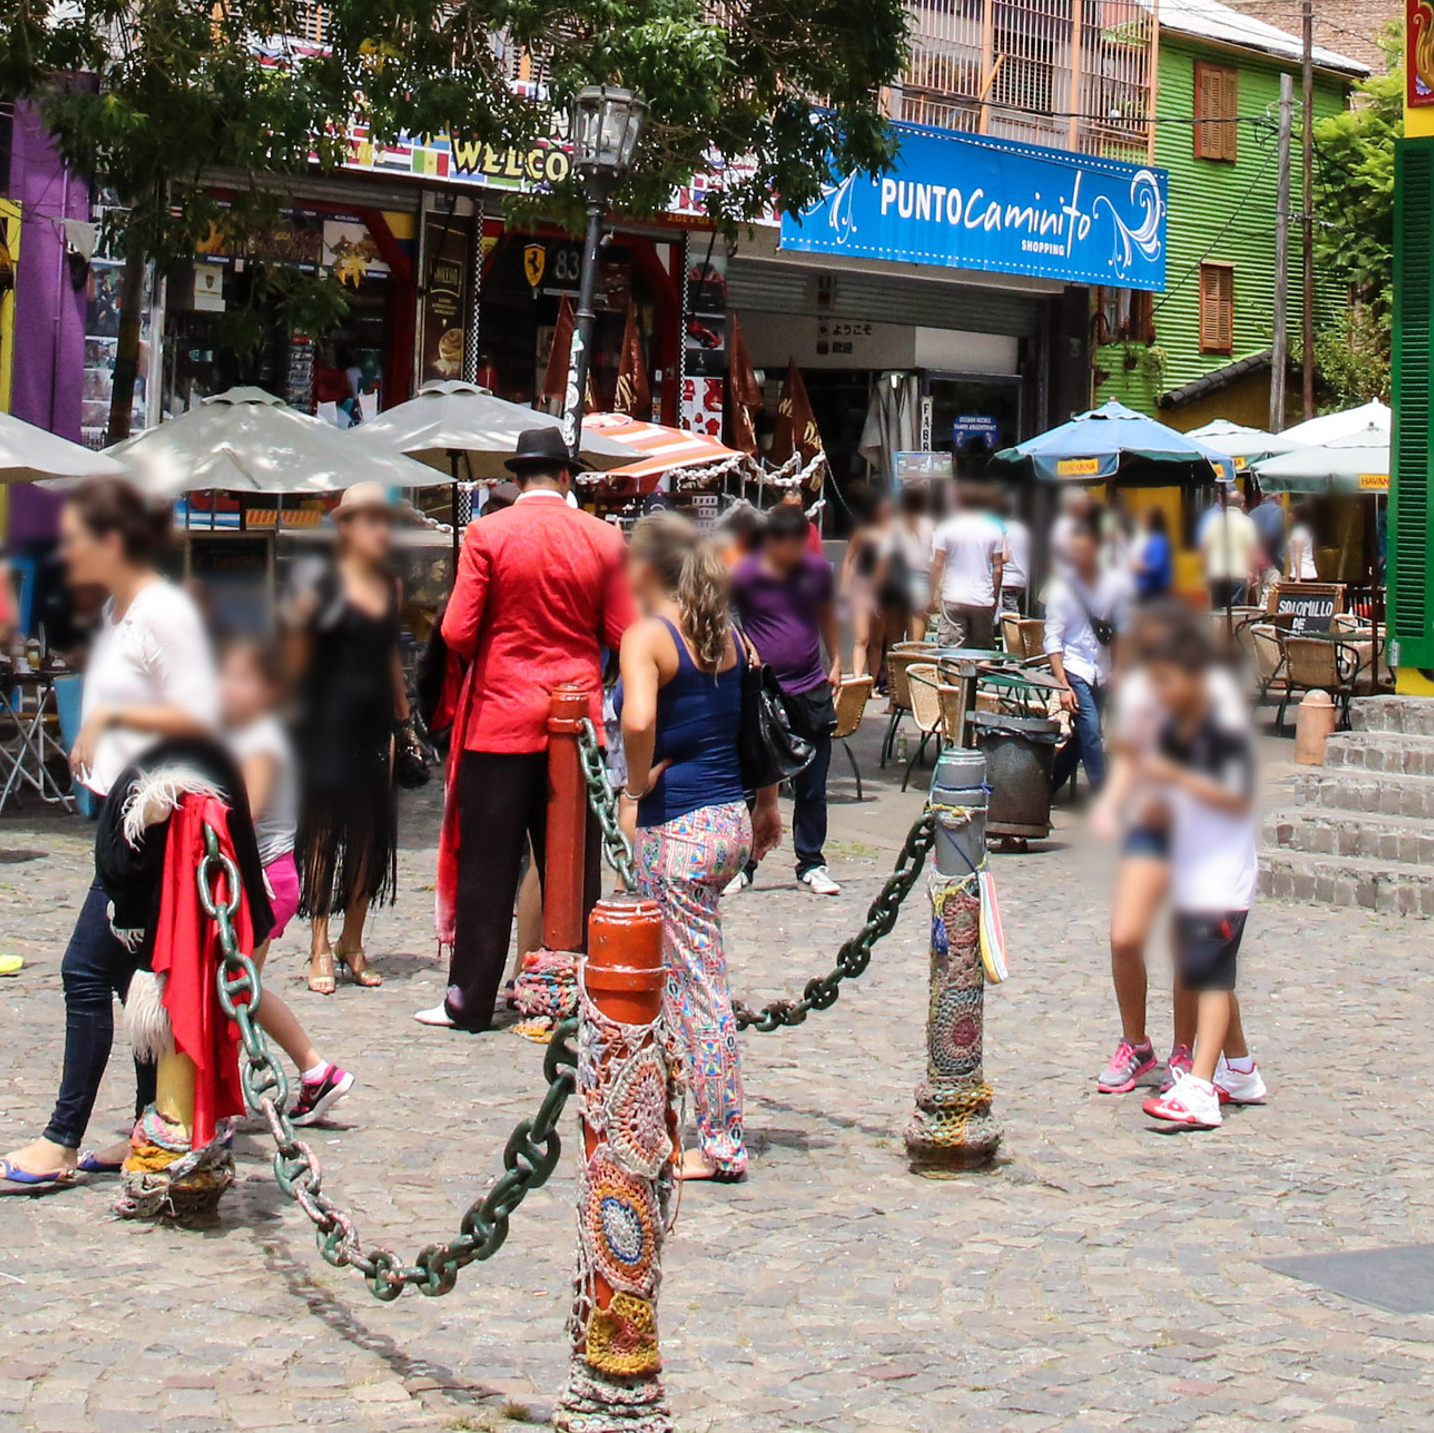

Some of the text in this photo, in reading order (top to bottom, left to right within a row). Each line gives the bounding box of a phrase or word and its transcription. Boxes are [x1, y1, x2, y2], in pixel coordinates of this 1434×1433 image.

[453, 138, 569, 182] WELCO
[880, 169, 1092, 258] PUNTO Caminito
[1021, 239, 1065, 257] SHOPPING
[554, 249, 580, 281] 83
[833, 324, 872, 336] ようこそ
[1360, 477, 1390, 487] HAVAN
[1278, 598, 1334, 617] SOLOMILLO
[1292, 618, 1306, 630] DE
